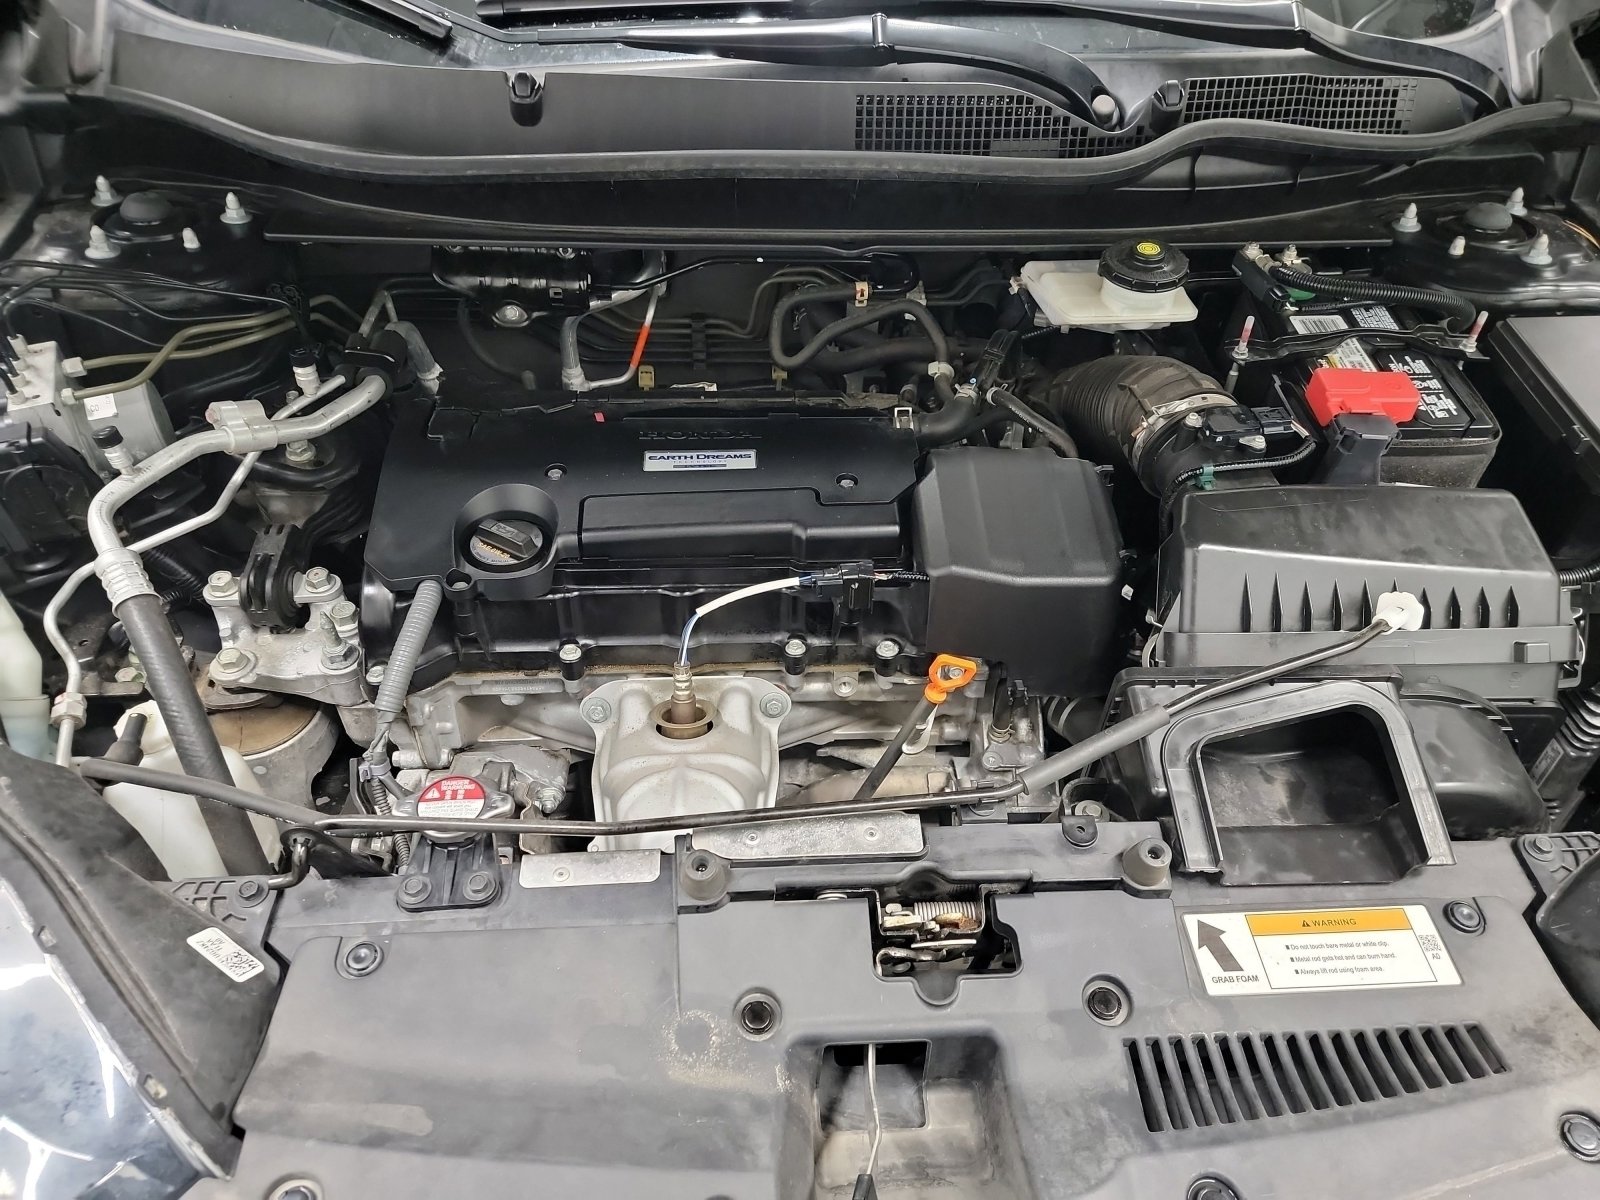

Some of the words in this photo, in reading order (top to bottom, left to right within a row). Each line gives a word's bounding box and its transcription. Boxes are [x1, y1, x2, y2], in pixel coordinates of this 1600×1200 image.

[638, 431, 763, 440] HONDA
[1311, 918, 1357, 928] WARNING
[1211, 976, 1235, 984] GRAB
[1235, 974, 1260, 983] FOAM
